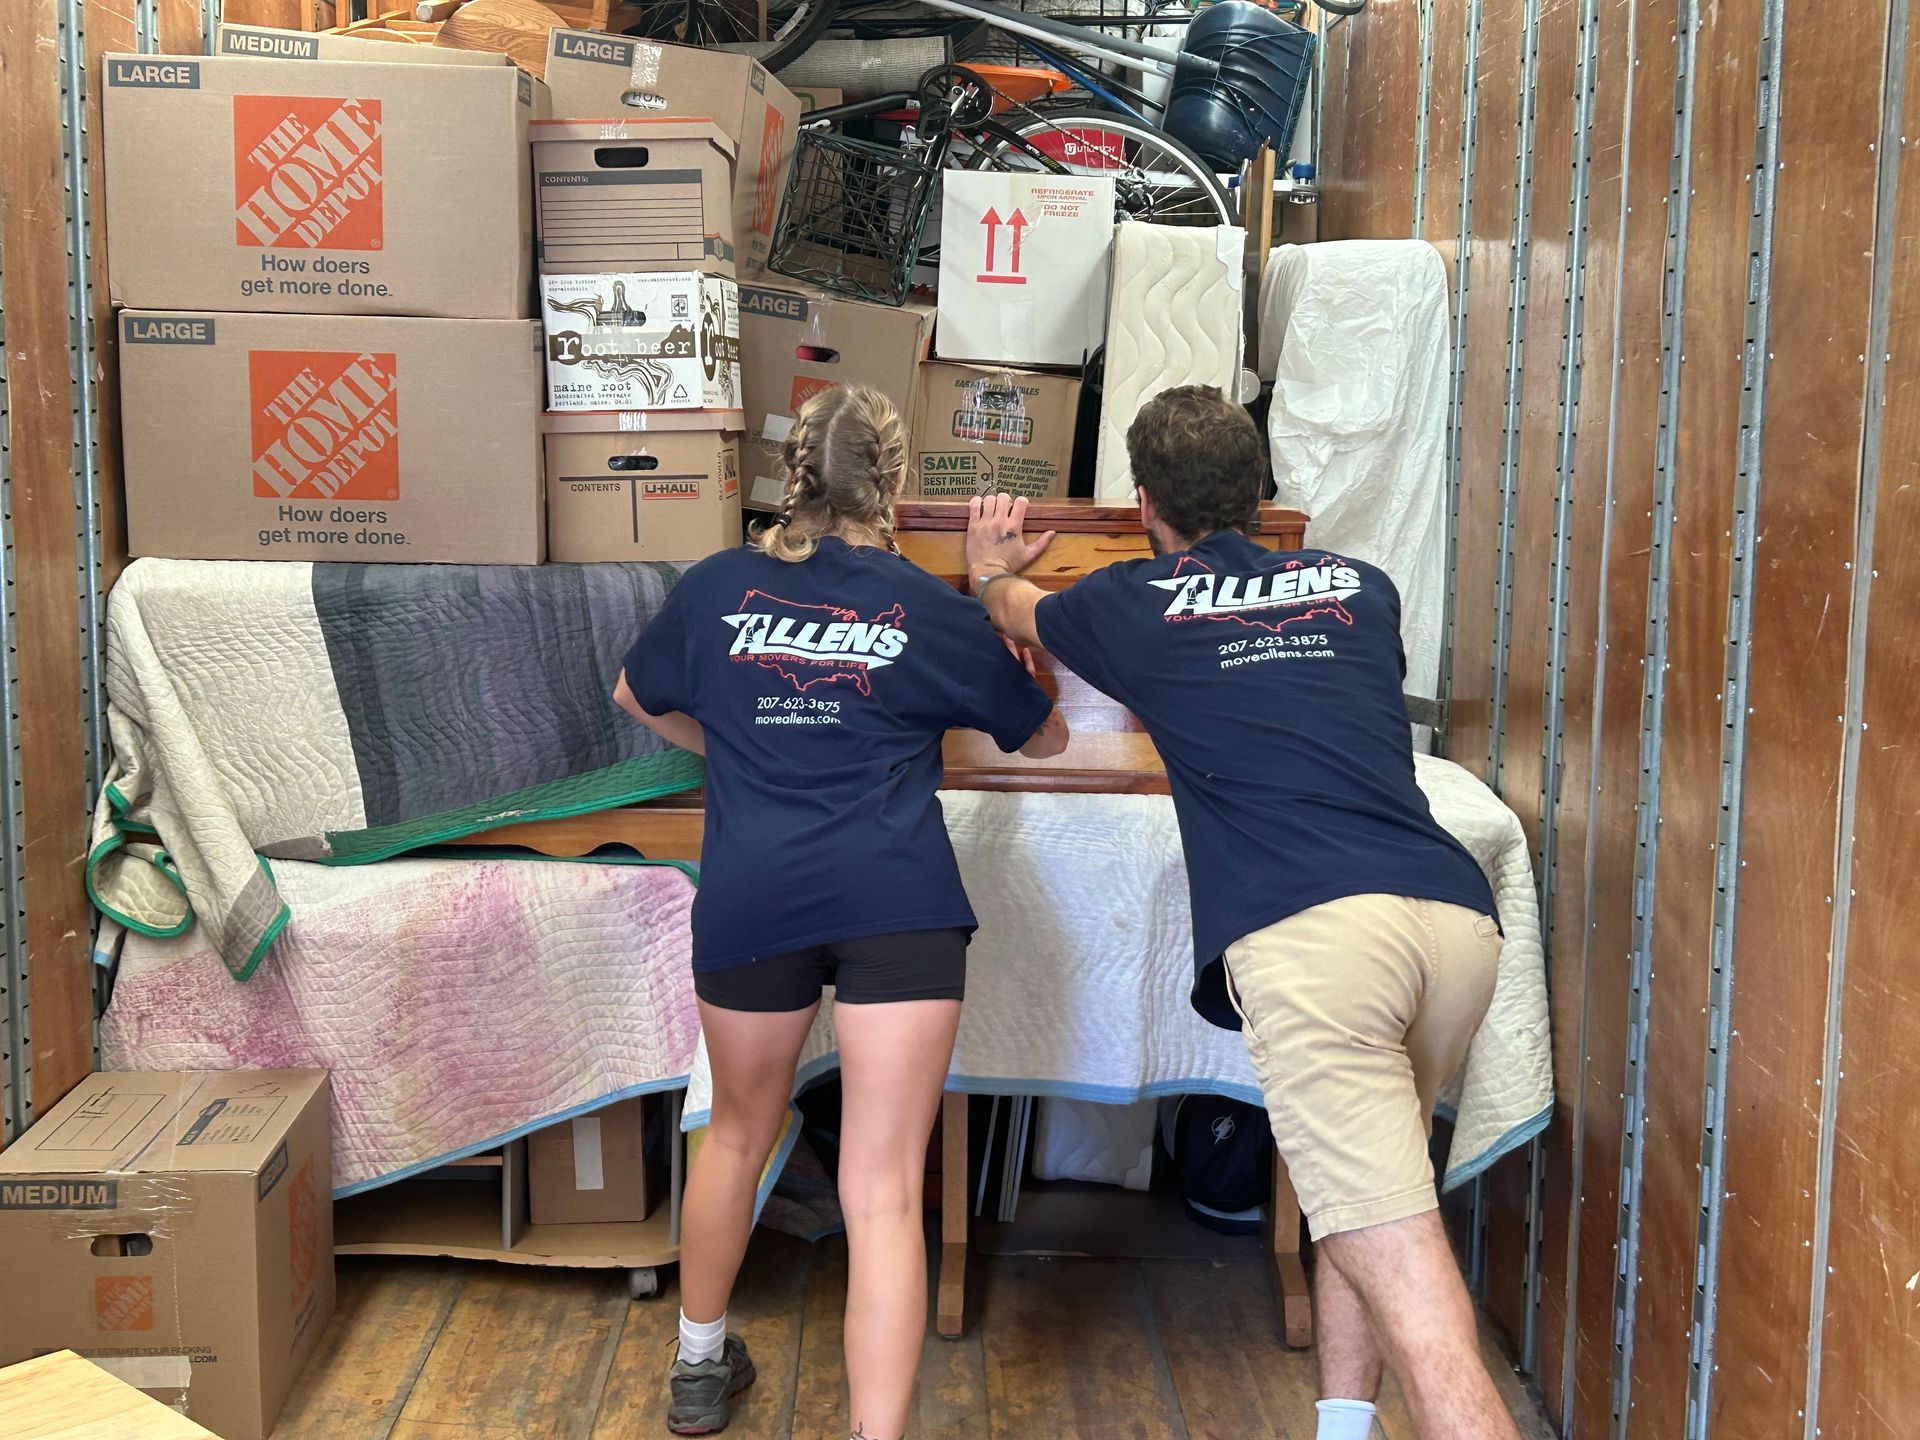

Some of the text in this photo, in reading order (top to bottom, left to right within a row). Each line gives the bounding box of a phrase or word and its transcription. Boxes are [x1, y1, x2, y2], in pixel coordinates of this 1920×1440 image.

[229, 34, 311, 57] MEDIUM
[562, 38, 625, 62] LARGE
[116, 65, 191, 84] LARGE
[247, 112, 310, 173] THE
[236, 97, 383, 248] HOME
[293, 155, 383, 249] DEPOT
[1031, 188, 1095, 197] REFRIGERATE
[1043, 210, 1079, 218] FREEZE
[261, 254, 371, 275] How doers
[241, 277, 274, 298] get
[279, 280, 332, 296] more
[738, 291, 801, 317] LARGE
[131, 322, 206, 340] LARGE
[557, 336, 691, 361] root beer
[263, 367, 326, 427] THE
[553, 382, 632, 392] maine root
[252, 352, 398, 498] HOME
[309, 408, 398, 500] DEPOT
[923, 456, 977, 471] SAVE!
[998, 464, 1016, 472] SAVE
[1017, 466, 1035, 475] EVEN
[570, 483, 621, 492] CONTENTS
[923, 476, 977, 486] BEST PRICE
[997, 479, 1017, 487] Prices
[278, 505, 388, 525] How doers
[258, 527, 292, 548] get
[296, 529, 350, 545] more
[1147, 564, 1361, 616] ALLEN'S
[721, 613, 909, 659] ALLEN'S
[1218, 634, 1328, 655] 207-623-3875
[759, 654, 807, 665] MOVERS
[810, 659, 835, 668] FOR
[838, 661, 867, 671] LIFE
[1220, 648, 1335, 669] moveallens.com
[757, 697, 841, 714] 207-623-3875
[755, 712, 841, 726] moveallens.com
[2, 1185, 107, 1205] MEDIUM
